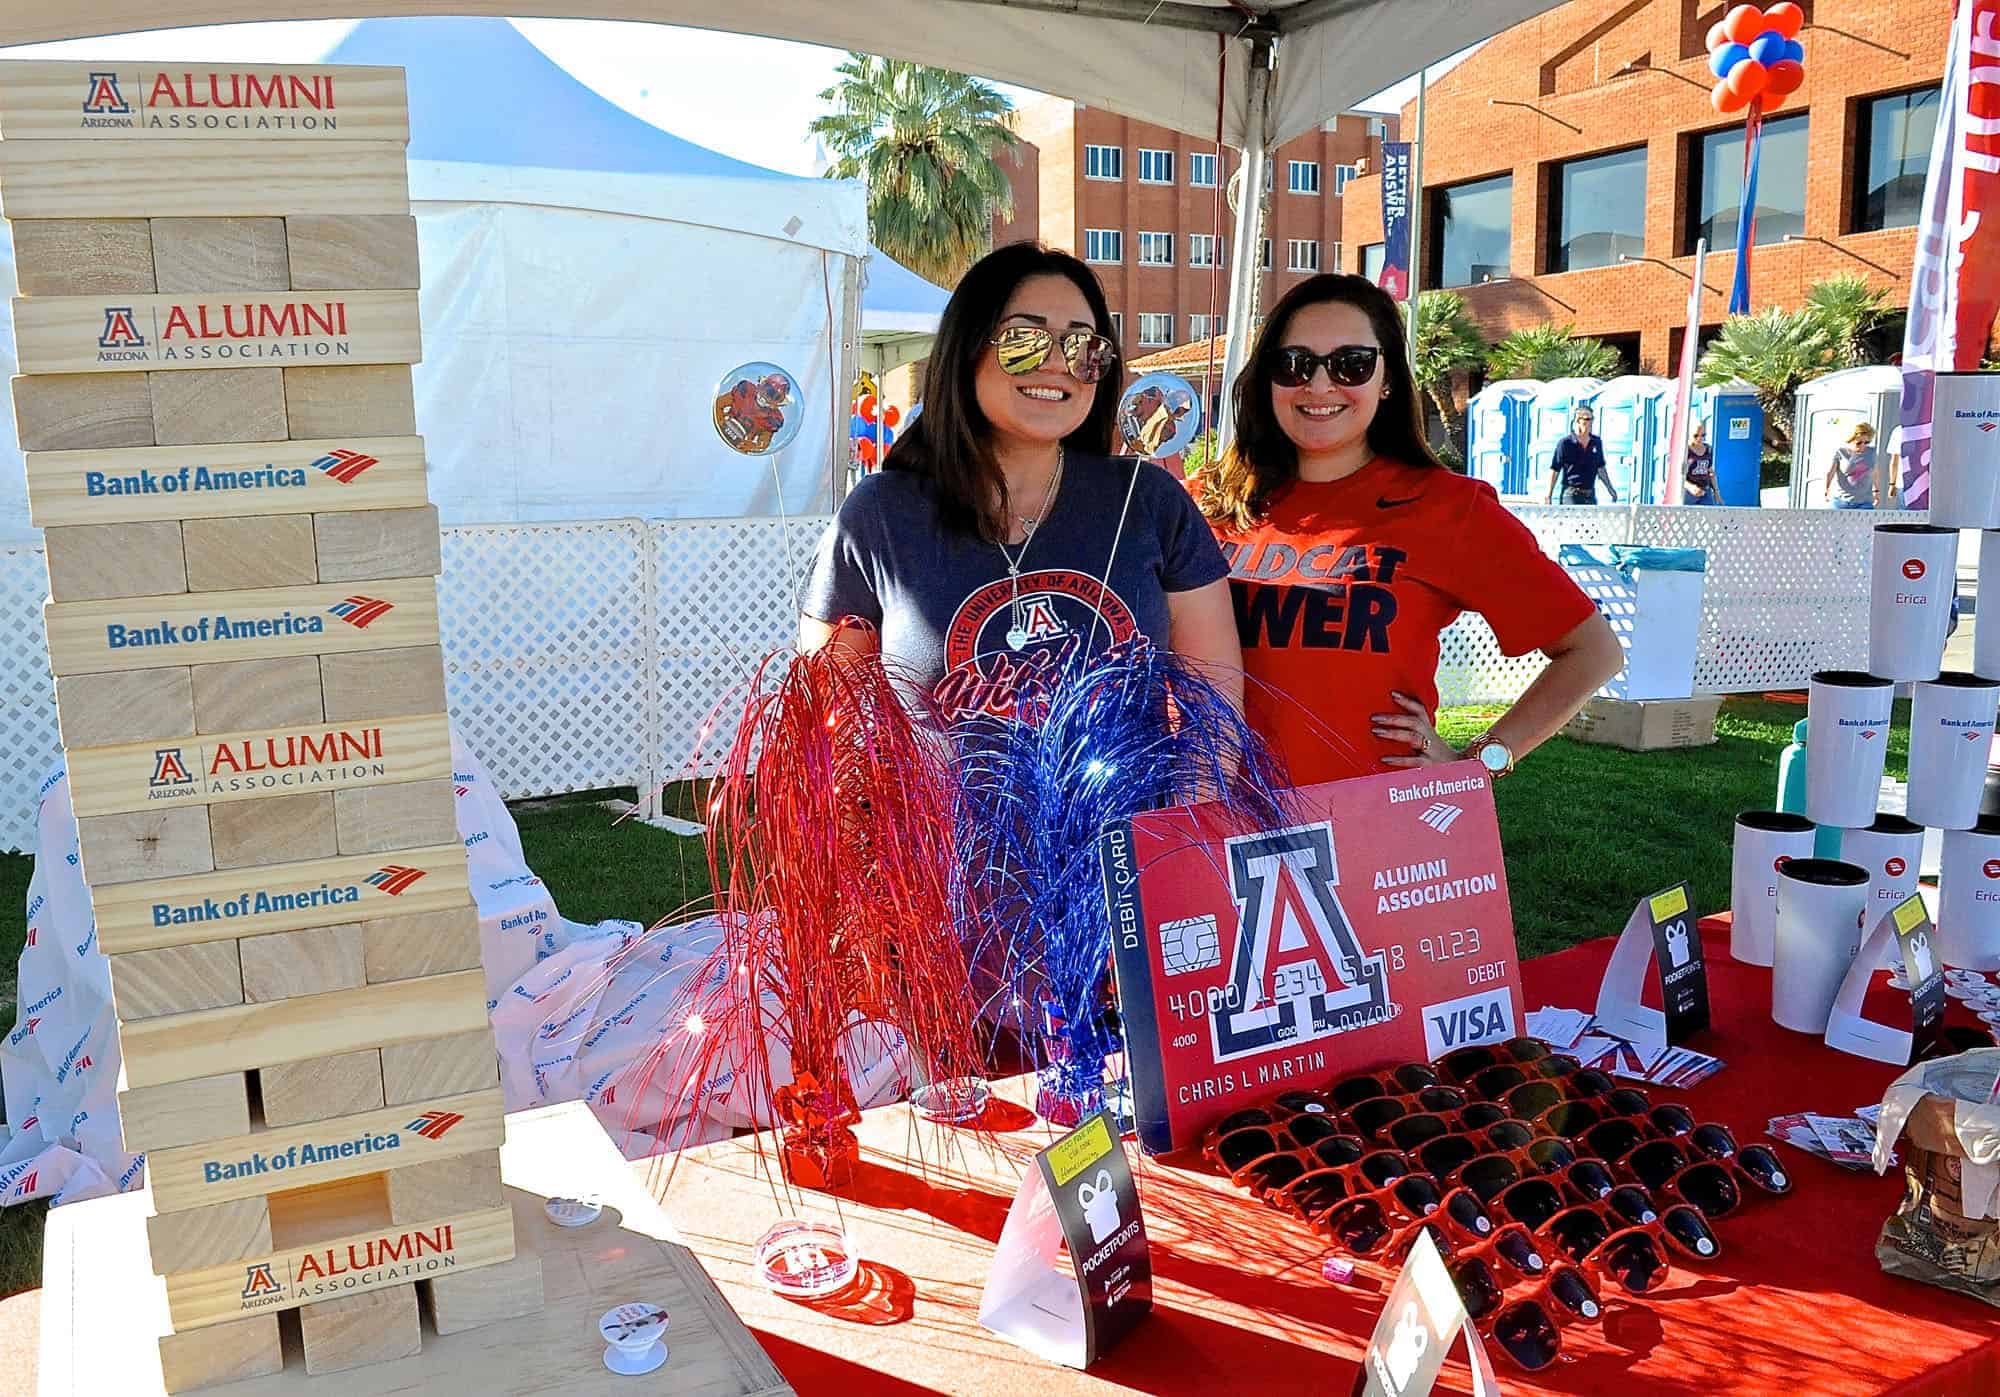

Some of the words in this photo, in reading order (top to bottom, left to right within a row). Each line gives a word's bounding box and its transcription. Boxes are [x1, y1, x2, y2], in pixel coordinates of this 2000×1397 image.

[148, 73, 335, 109] ALUMNI
[81, 117, 133, 128] ARIZONA
[150, 115, 337, 130] ASSOCIATION
[163, 303, 347, 340] ALUMNI
[97, 351, 149, 361] ARIZONA
[165, 342, 349, 360] ASSOCIATION
[1955, 410, 1976, 418] Bank
[1977, 410, 1986, 418] of
[86, 471, 158, 496] Bank
[162, 467, 189, 493] of
[194, 464, 306, 491] America
[1222, 542, 1407, 584] LDCAT
[953, 625, 972, 652] THE
[968, 577, 1041, 622] UNIVERITY
[1046, 575, 1067, 588] OF
[1895, 592, 1928, 605] Erica
[107, 621, 178, 648] Bank
[182, 618, 209, 643] of
[213, 612, 323, 641] America
[1228, 582, 1398, 653] WER
[1839, 718, 1859, 727] Bank
[1859, 718, 1868, 727] of
[1940, 718, 1961, 727] Bank
[1961, 719, 1970, 727] of
[210, 728, 383, 774] ALUMNI
[148, 787, 196, 799] ARIZONA
[212, 765, 384, 793] ASSOCIATION
[1389, 784, 1421, 803] Bank
[1422, 781, 1434, 798] of
[1436, 776, 1485, 796] America
[1111, 830, 1129, 884] CARD
[1373, 859, 1447, 890] ALUMNI
[153, 896, 221, 927] Bank
[224, 893, 250, 917] of
[254, 884, 359, 913] America
[1377, 873, 1497, 914] ASSOCIATION
[1878, 888, 1906, 900] Erica
[501, 914, 523, 930] Bank
[1118, 892, 1138, 949] DEBIT
[1169, 983, 1240, 1021] 4000
[1419, 928, 1481, 962] 9123
[1467, 960, 1506, 985] DEBIT
[27, 986, 63, 1014] merica
[612, 993, 648, 1025] America
[1172, 1033, 1197, 1048] 4000
[1277, 1026, 1297, 1040] GOO
[1313, 1020, 1326, 1032] RU
[1430, 1001, 1506, 1047] VISA
[1179, 1074, 1234, 1104] CHRIS
[1241, 1071, 1252, 1088] L
[1259, 1051, 1325, 1084] MARTIN
[204, 1153, 267, 1183] Bank
[270, 1148, 296, 1168] of
[300, 1129, 400, 1165] America
[296, 1225, 453, 1282] ALUMNI
[1082, 1220, 1140, 1277] POCKETPOINTS
[241, 1296, 285, 1310] ARIZONA
[299, 1255, 456, 1297] ASSOCIATION
